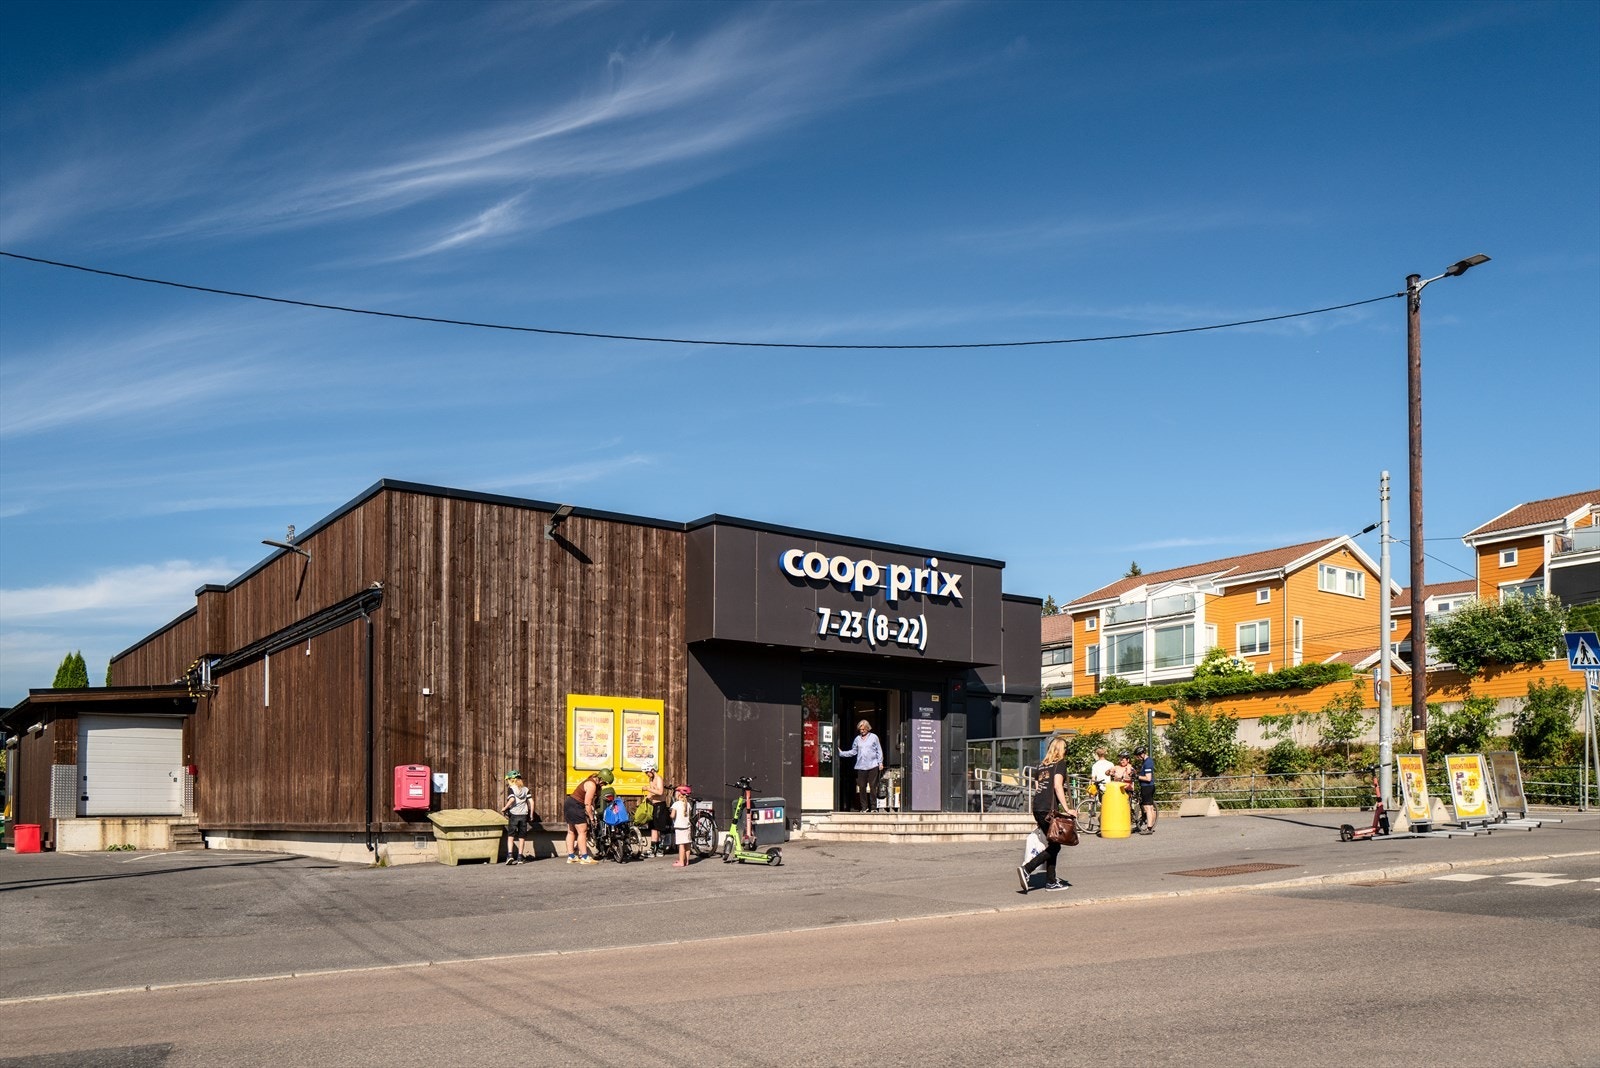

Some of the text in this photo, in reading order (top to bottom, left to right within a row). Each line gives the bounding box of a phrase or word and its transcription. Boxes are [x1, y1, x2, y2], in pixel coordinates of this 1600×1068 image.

[780, 549, 963, 601] coop prix
[818, 607, 928, 651] 7-23 (8-22)
